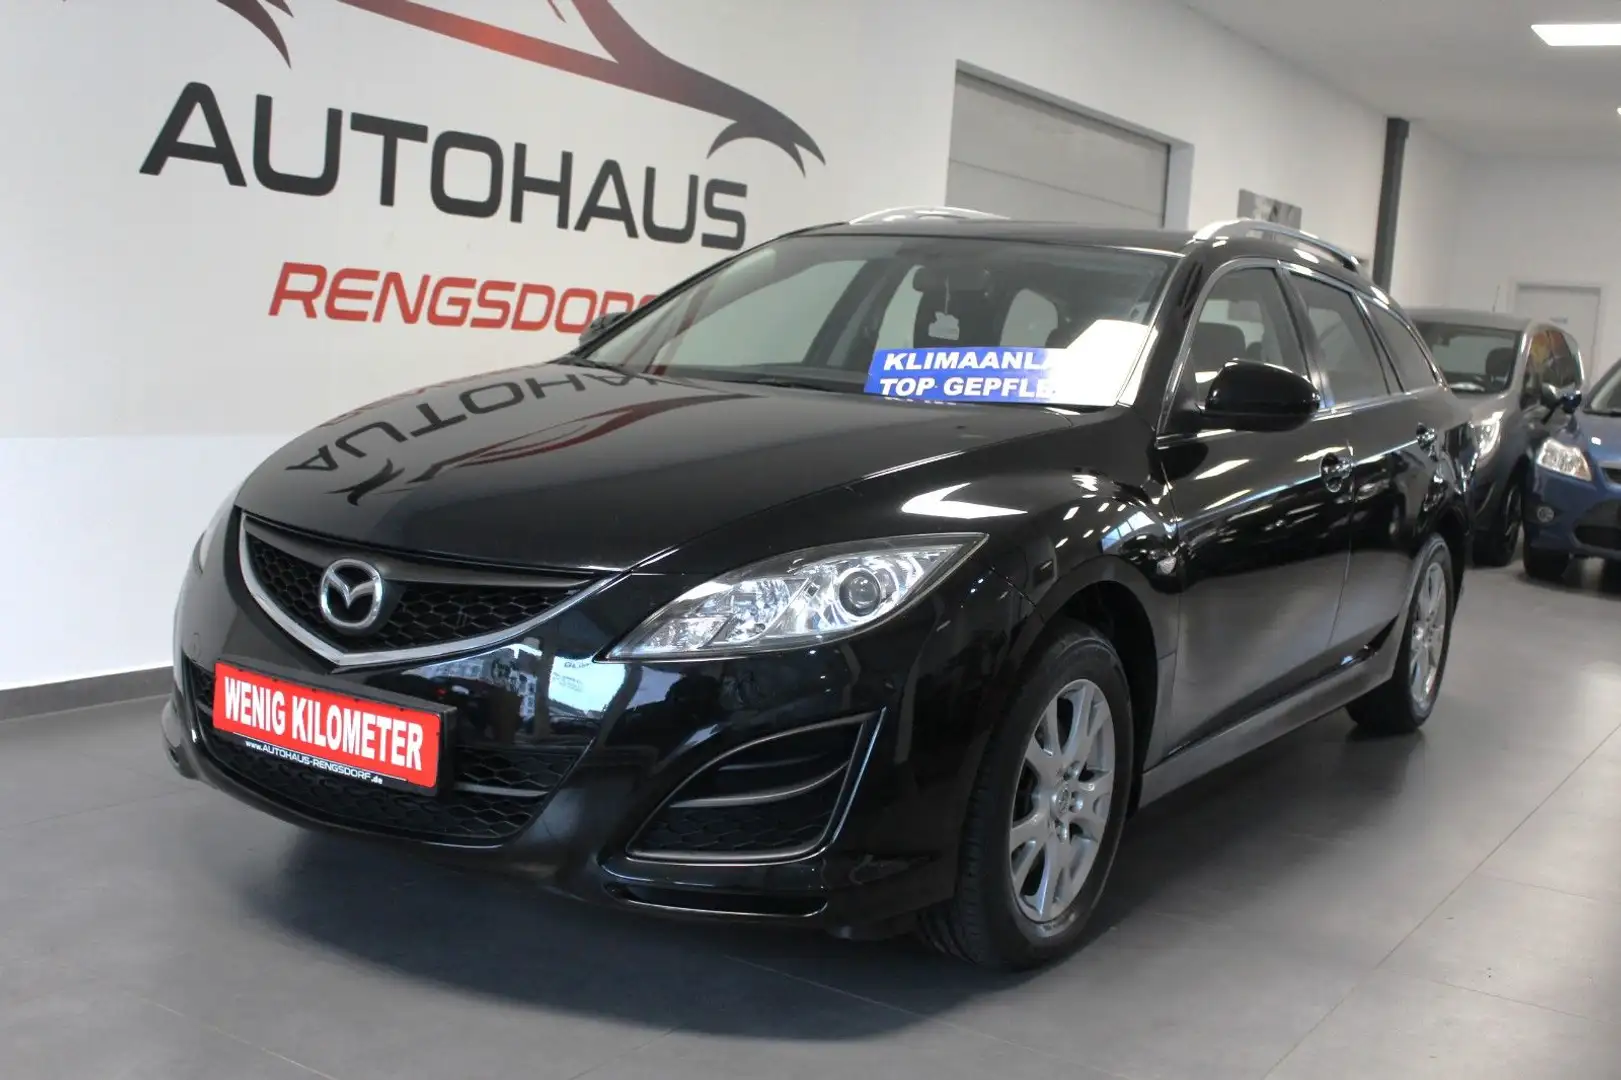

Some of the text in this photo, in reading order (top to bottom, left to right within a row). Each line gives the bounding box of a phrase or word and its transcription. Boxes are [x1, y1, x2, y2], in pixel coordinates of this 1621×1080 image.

[139, 81, 748, 251] AUTOHAUS
[269, 261, 660, 333] RENGSDO
[879, 377, 937, 396] TOP
[224, 676, 423, 771] WENIG KILOMETER
[245, 740, 383, 785] www.AUTOHAUS-RENGSDORF.de
